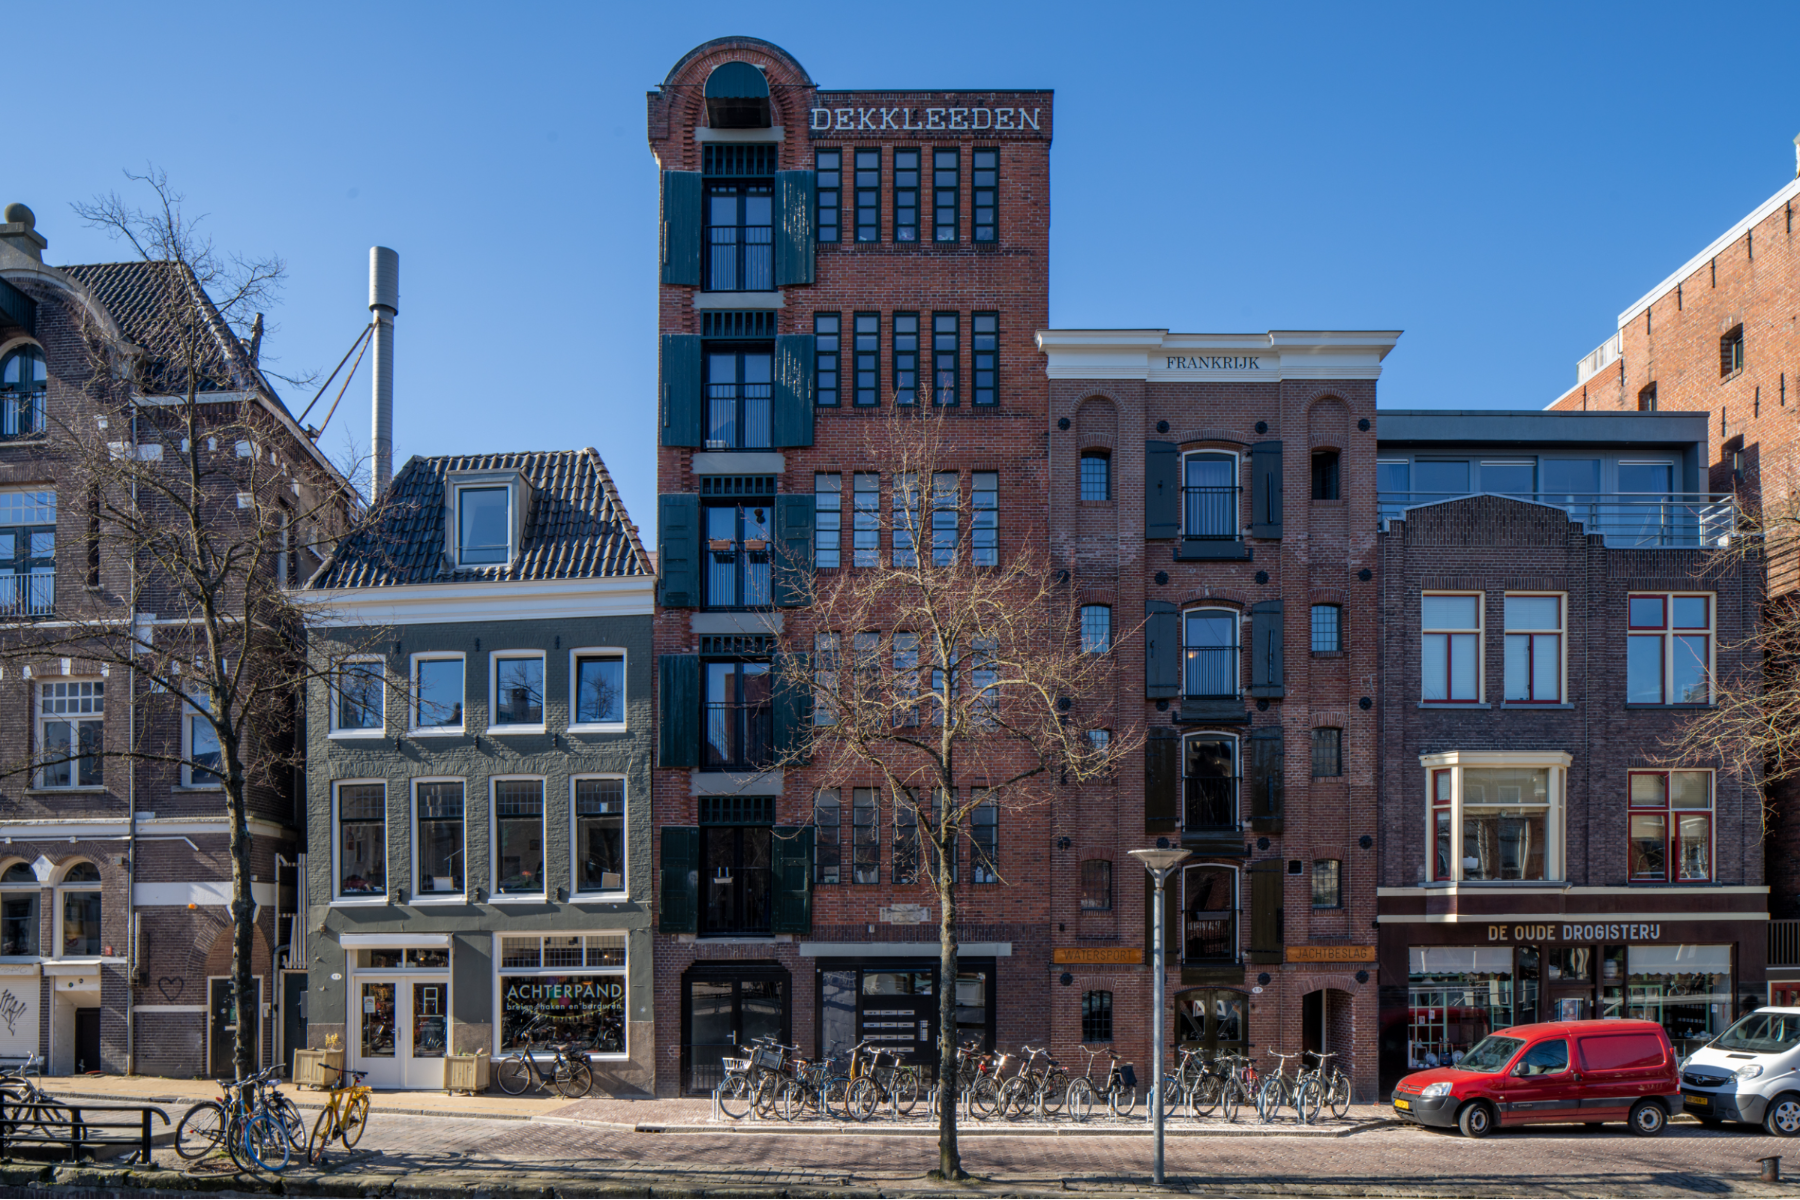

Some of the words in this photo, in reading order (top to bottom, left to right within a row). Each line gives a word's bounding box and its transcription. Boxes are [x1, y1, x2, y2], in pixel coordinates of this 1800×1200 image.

[810, 107, 1041, 130] DEKKLEEDEN
[1165, 356, 1260, 369] FRANKRIJK
[1487, 925, 1508, 941] DE
[1514, 925, 1556, 941] OUDE
[1562, 923, 1661, 940] DROGISTERIJ
[1063, 949, 1133, 961] WATERSPORT
[1295, 948, 1368, 959] JACHTBESLAG
[506, 983, 623, 999] ACHTERPAND
[540, 1002, 566, 1010] haken
